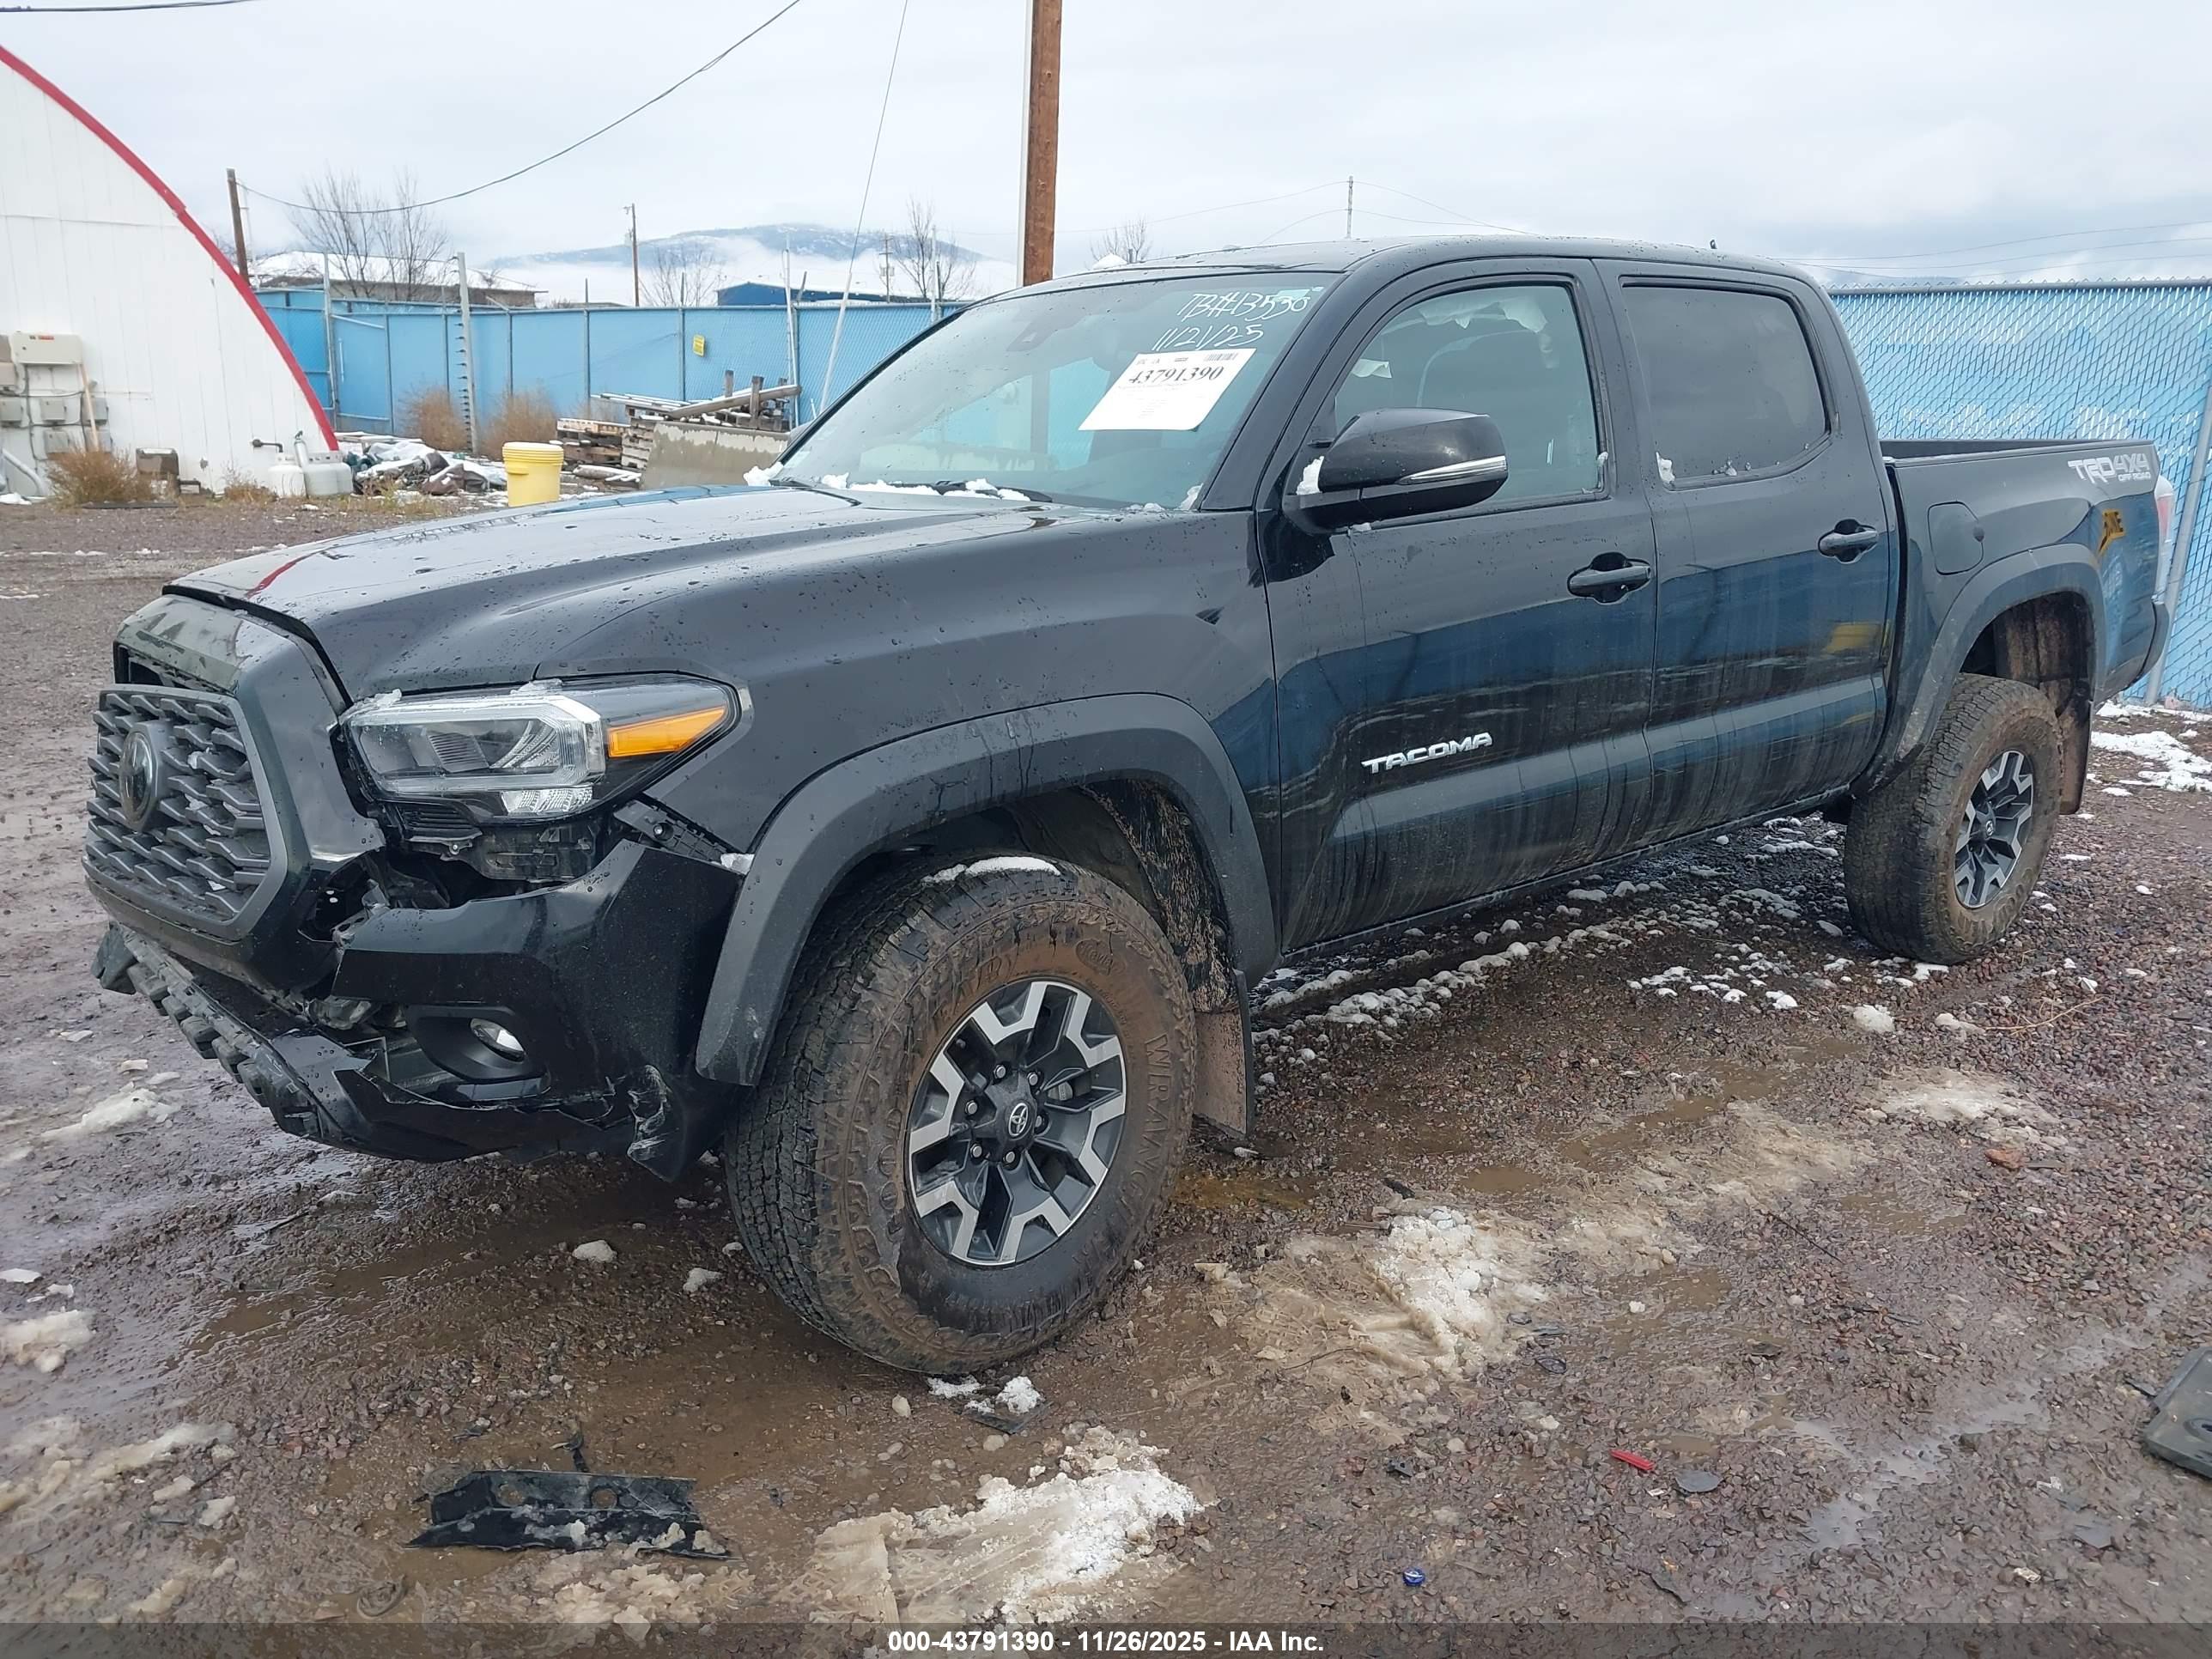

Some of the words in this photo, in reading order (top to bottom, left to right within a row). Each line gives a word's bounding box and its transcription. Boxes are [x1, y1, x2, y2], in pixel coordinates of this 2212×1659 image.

[1128, 366, 1225, 384] 43791390
[2067, 457, 2117, 484] TRD
[2118, 473, 2131, 482] OFF
[2132, 471, 2151, 481] ROAD
[1360, 732, 1493, 774] TACOMA
